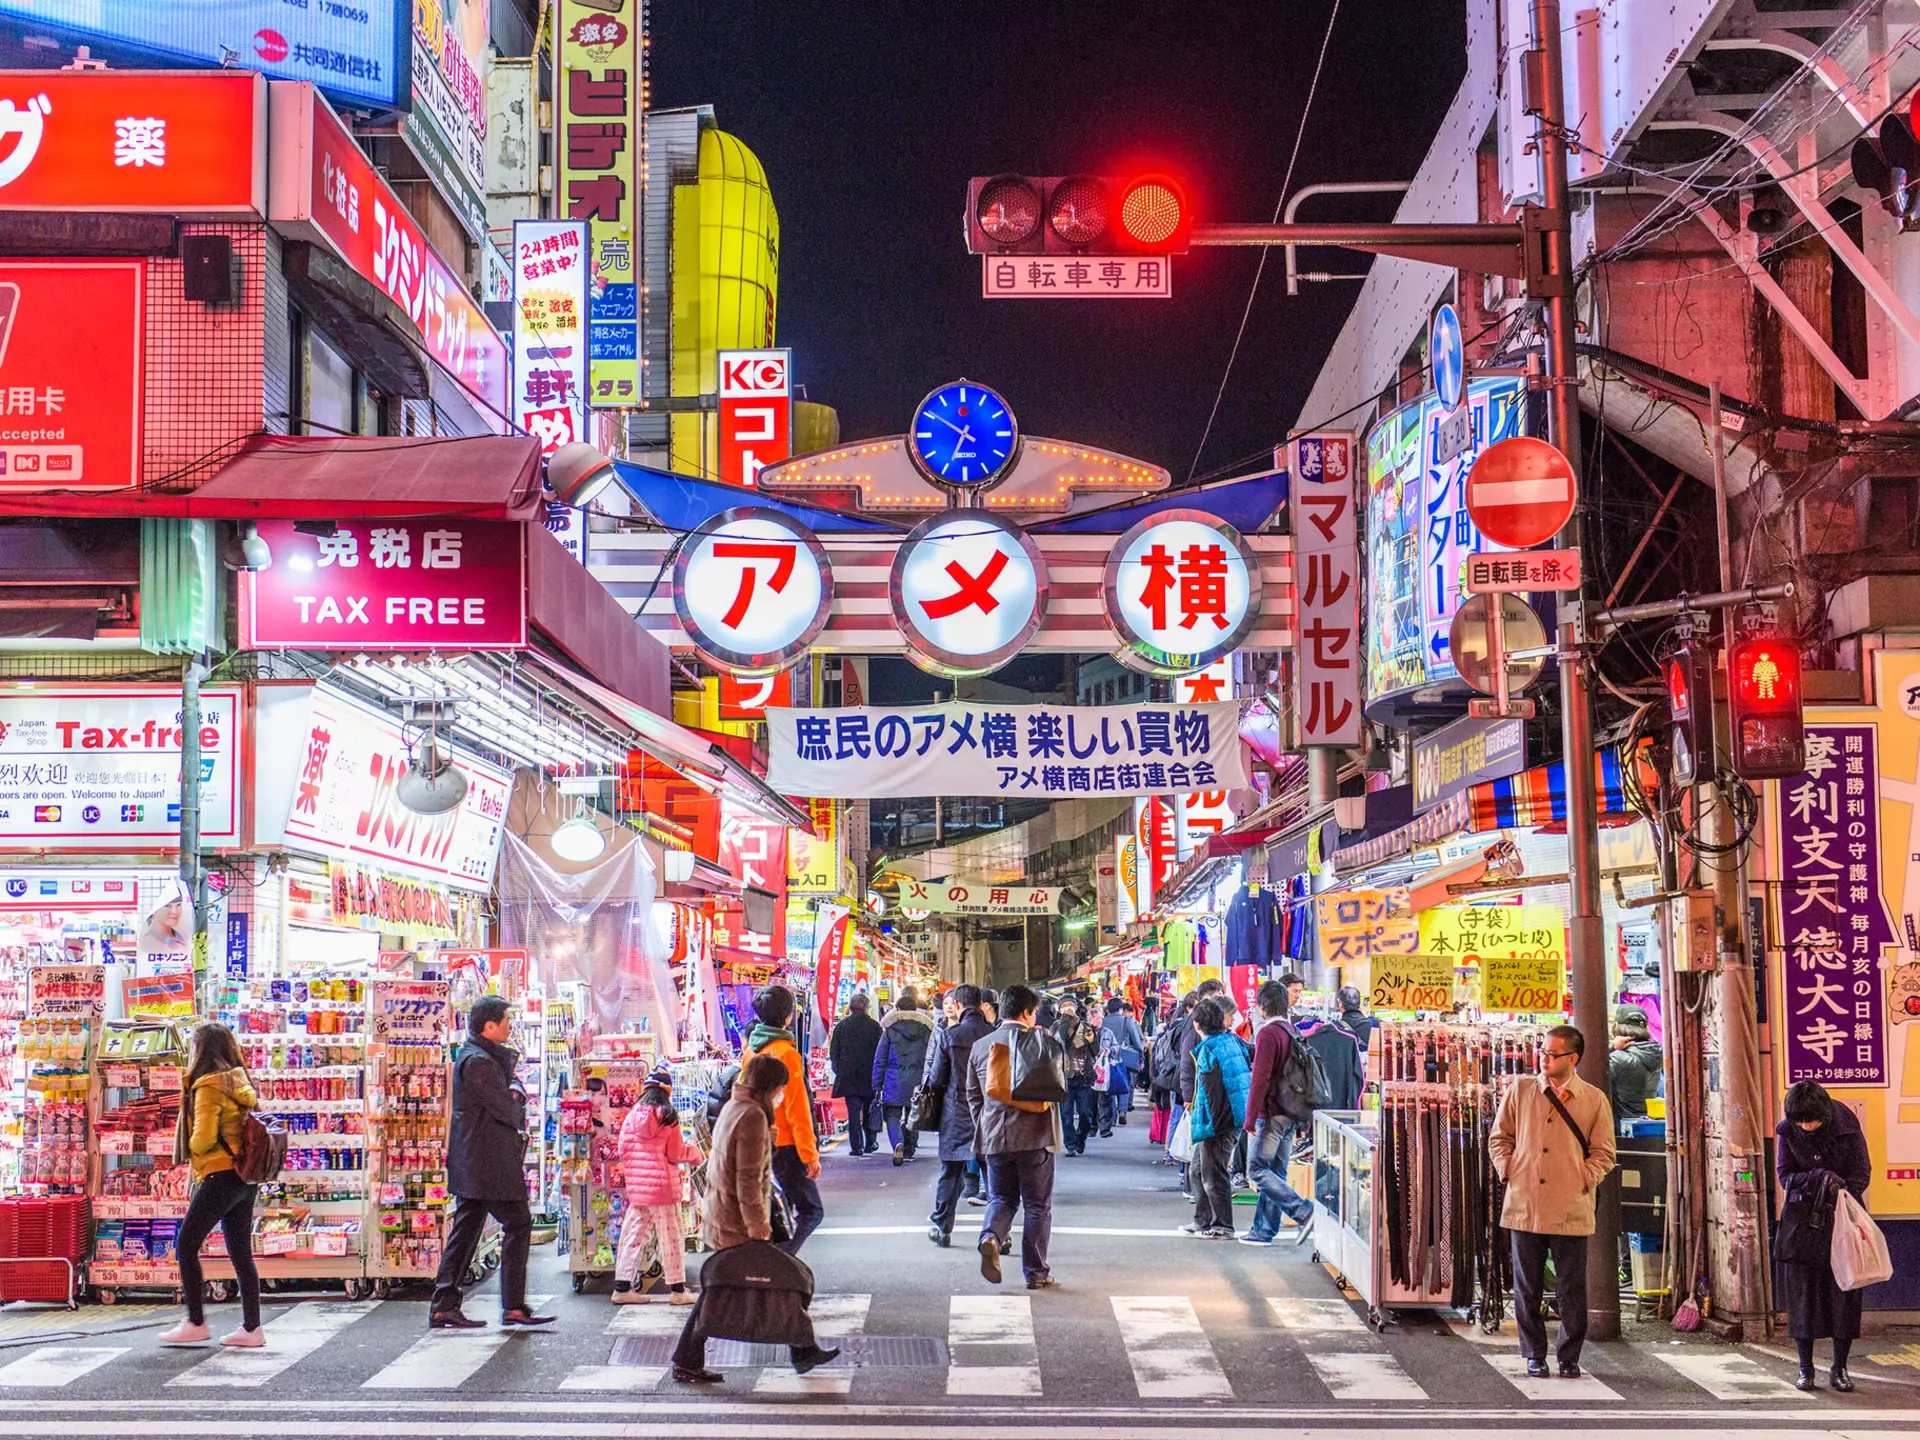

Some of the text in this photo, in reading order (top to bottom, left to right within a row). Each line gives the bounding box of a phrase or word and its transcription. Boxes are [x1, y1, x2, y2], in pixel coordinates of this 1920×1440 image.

[579, 22, 619, 43] 激安
[293, 42, 381, 81] 共同通信社
[115, 117, 166, 167] 薬
[323, 151, 359, 235] 化粧品
[520, 230, 580, 260] 24時間
[523, 253, 578, 281] 営業中!
[995, 261, 1160, 289] 自転車専用
[374, 198, 467, 375] コクミンドラッグ
[549, 299, 573, 313] 激安
[591, 327, 634, 338] ・有名メーカー
[591, 344, 634, 356] 系・アイドル
[724, 359, 784, 390] KG
[591, 380, 633, 396] タラ
[0, 386, 65, 416] 用卡
[0, 428, 65, 442] ccepted
[1442, 425, 1466, 454] 8-20
[317, 528, 463, 569] 免税店
[1473, 559, 1575, 584] 自転車を除く
[293, 596, 486, 625] TAX FREE
[1301, 495, 1353, 735] マルセル
[15, 729, 47, 738] Tax-free
[18, 719, 48, 729] Japan.
[796, 710, 1210, 761] 庶民のアメ横 楽しい買物
[26, 738, 47, 747] Shop
[296, 725, 332, 815] 薬
[996, 760, 1218, 791] アメ横商店街連合会
[41, 792, 67, 800] open.
[71, 789, 117, 799] Welcome
[120, 791, 130, 799] to
[133, 789, 165, 800] Japan!
[83, 810, 100, 819] UC
[121, 808, 144, 818] JCB
[7, 882, 26, 892] UC
[802, 873, 827, 886] 入口
[909, 883, 1048, 904] 火の用心
[1789, 733, 1849, 1065] 摩利支天 徳大寺
[1844, 735, 1874, 1063] 開運勝利の守護神 毎月亥の日縁日
[1458, 907, 1511, 929] (手袋)
[1329, 927, 1419, 961] スポーツ
[148, 953, 188, 962] ロキソニン
[1377, 971, 1415, 989] ベルト
[1794, 1068, 1880, 1080] ココより徒歩30秒
